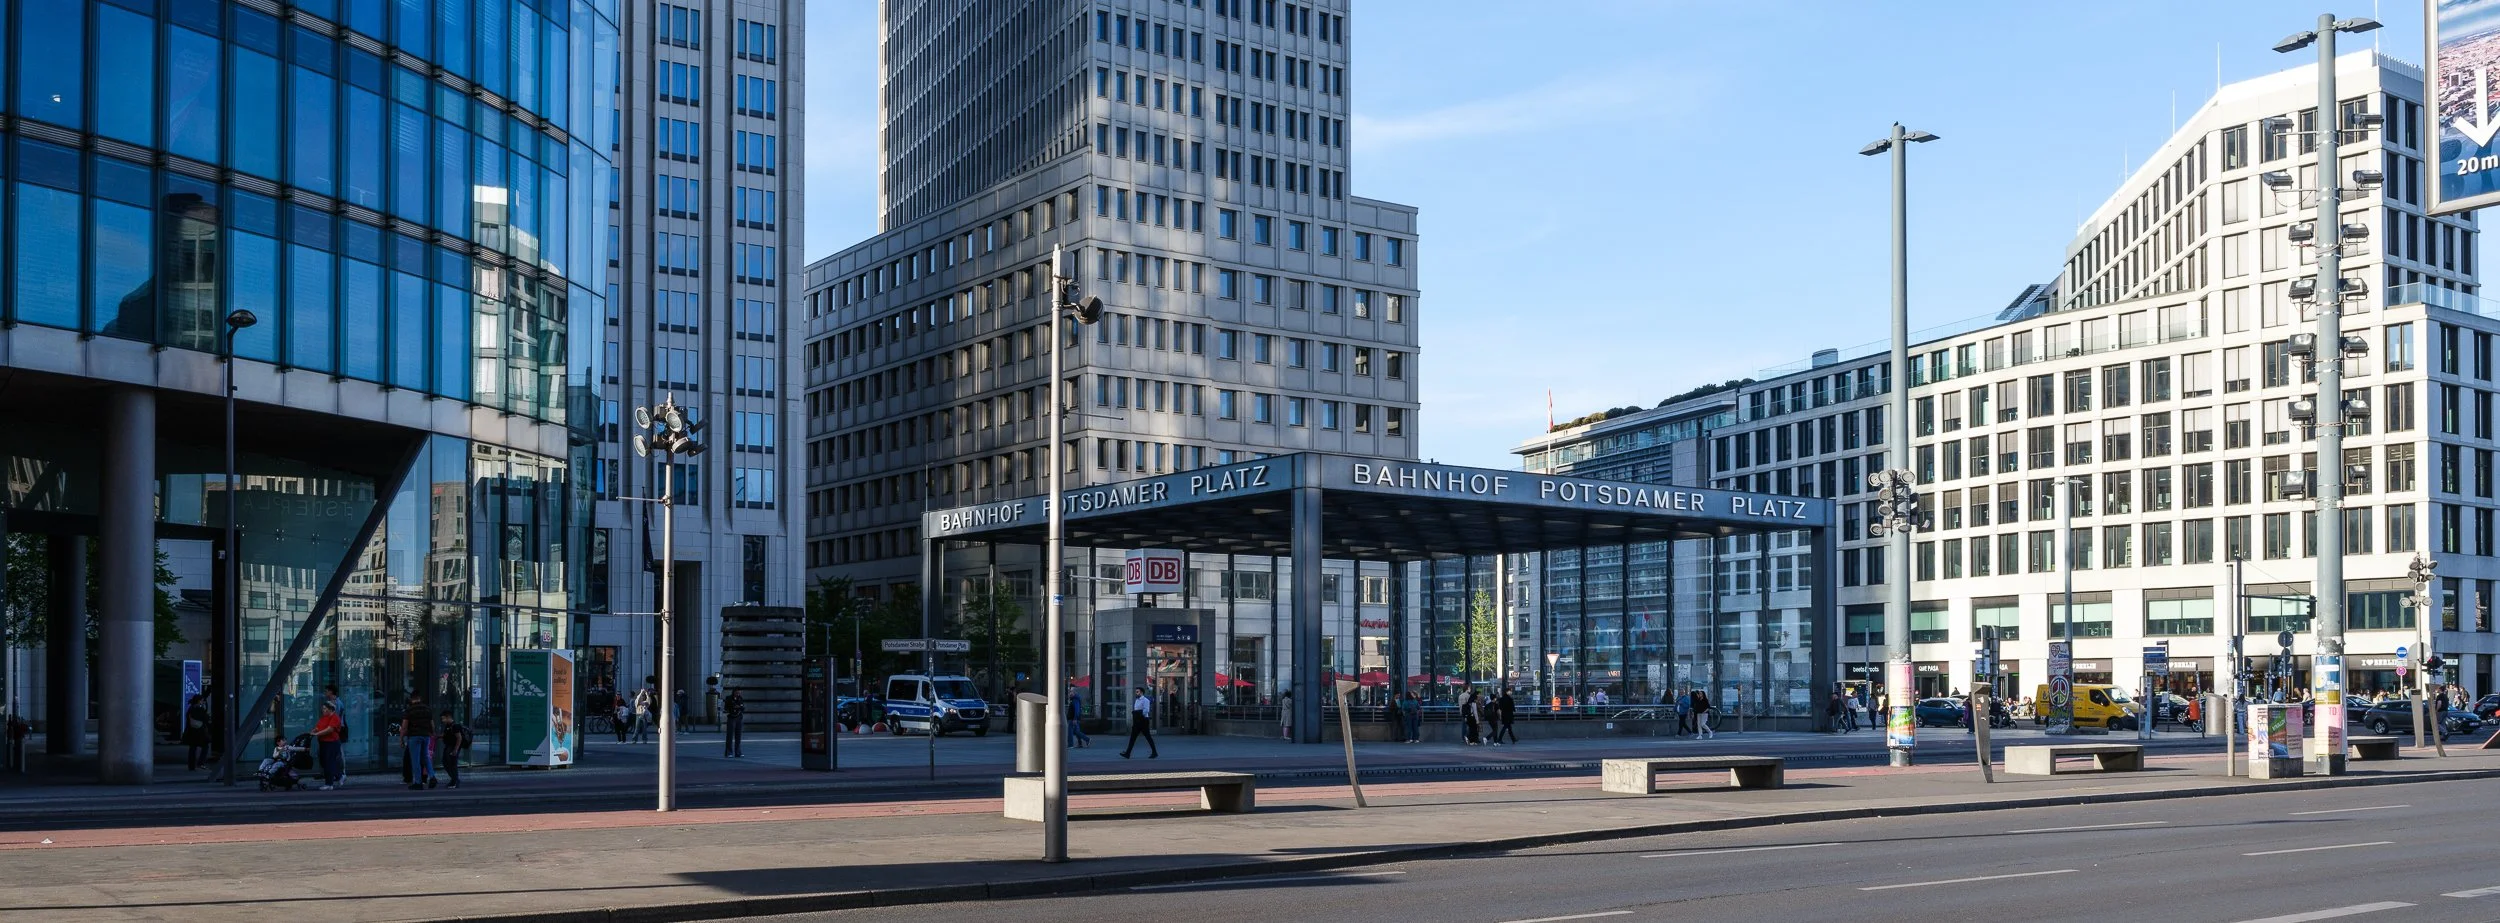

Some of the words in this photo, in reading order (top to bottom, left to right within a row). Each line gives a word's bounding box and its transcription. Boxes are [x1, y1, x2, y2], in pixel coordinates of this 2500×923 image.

[2457, 156, 2479, 176] 20
[941, 503, 1025, 532] BAHNHOF
[1042, 481, 1168, 517] PTSDAMER
[1190, 465, 1268, 496] PLATZ
[1353, 463, 1509, 495] BAHNHOF
[1540, 480, 1705, 512] POTSDAMER
[1732, 496, 1807, 520] PLATZ
[1128, 562, 1141, 581] DB
[1150, 561, 1177, 580] DB
[909, 641, 925, 649] Straße
